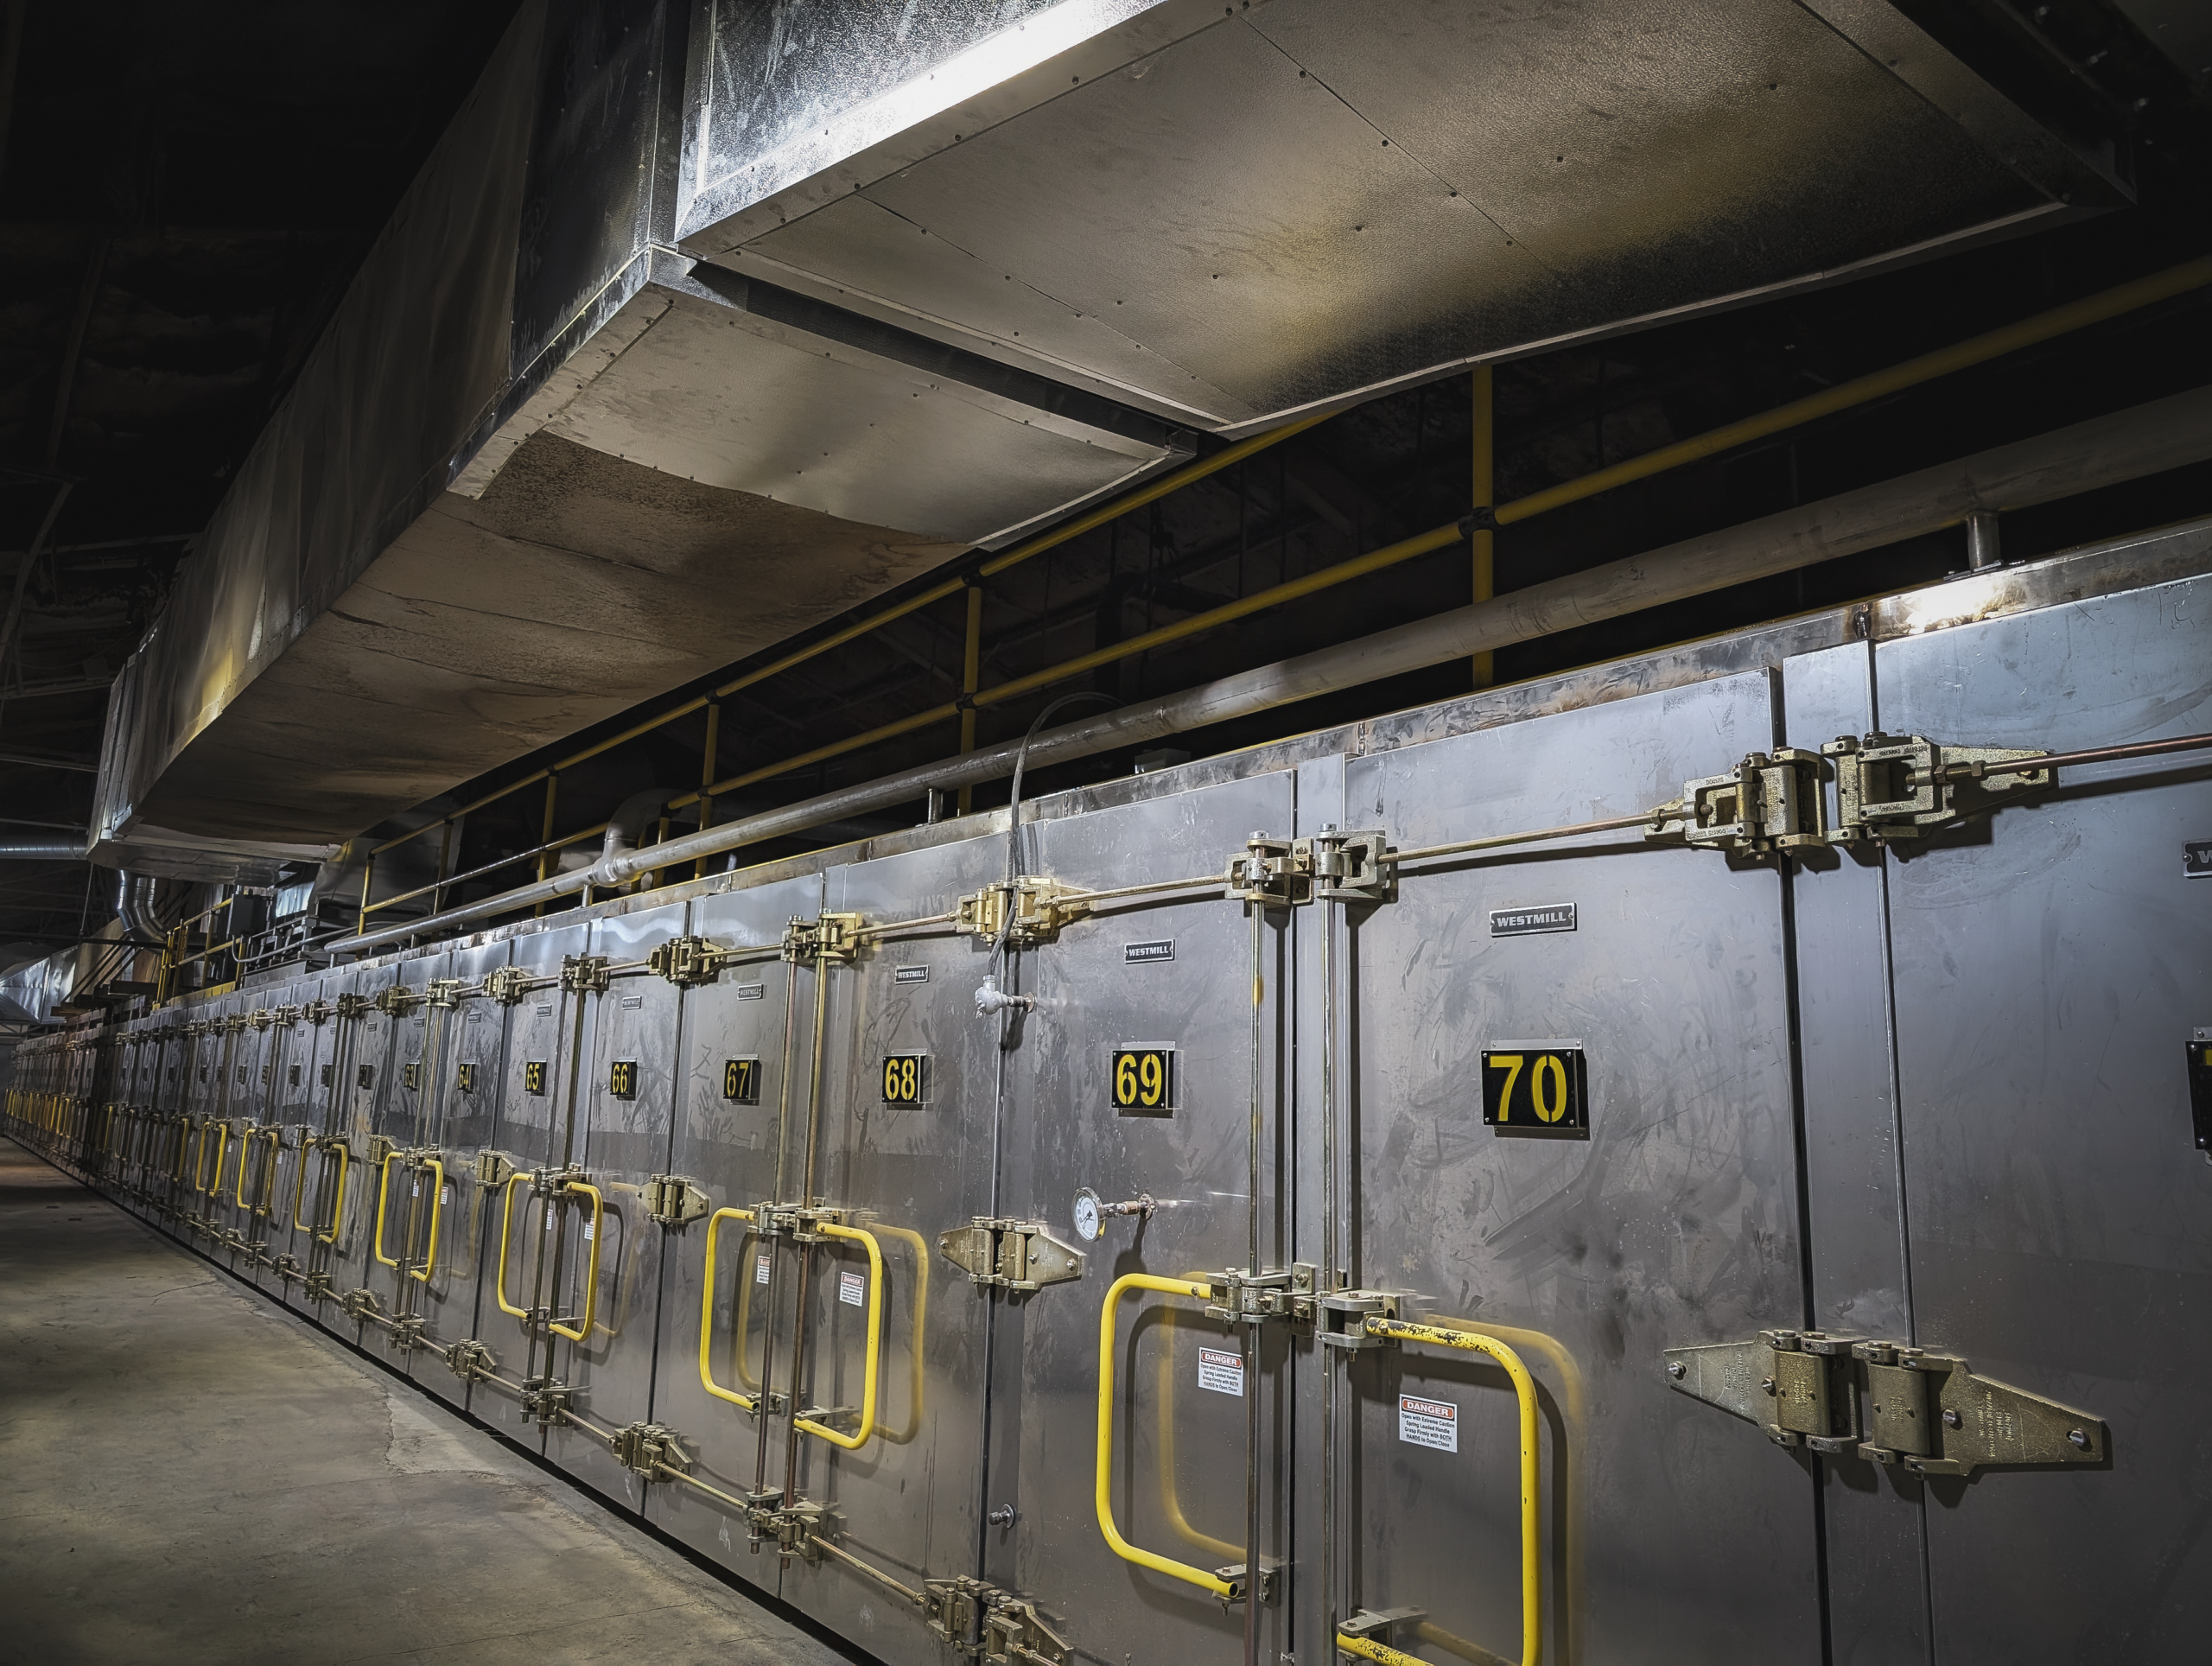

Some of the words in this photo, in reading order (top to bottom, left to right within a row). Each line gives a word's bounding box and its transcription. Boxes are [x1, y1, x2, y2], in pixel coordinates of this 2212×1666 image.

[1497, 911, 1567, 927] WESTMILL
[1128, 946, 1169, 959] WESTMILL
[898, 969, 925, 980] WESTMILL
[459, 1064, 470, 1091] 64
[526, 1064, 540, 1091] 65
[612, 1063, 628, 1095] 66
[727, 1062, 749, 1098] 67
[884, 1058, 917, 1102] 68
[1116, 1053, 1163, 1106] 69
[1489, 1053, 1567, 1122] 70
[1205, 1353, 1236, 1365] DANGER
[1407, 1402, 1448, 1415] DANGER
[1406, 1420, 1420, 1428] Spring
[1420, 1422, 1435, 1431] Loaded
[1439, 1420, 1455, 1428] Caution
[1406, 1433, 1421, 1441] HANDS
[1440, 1434, 1452, 1442] BOTH
